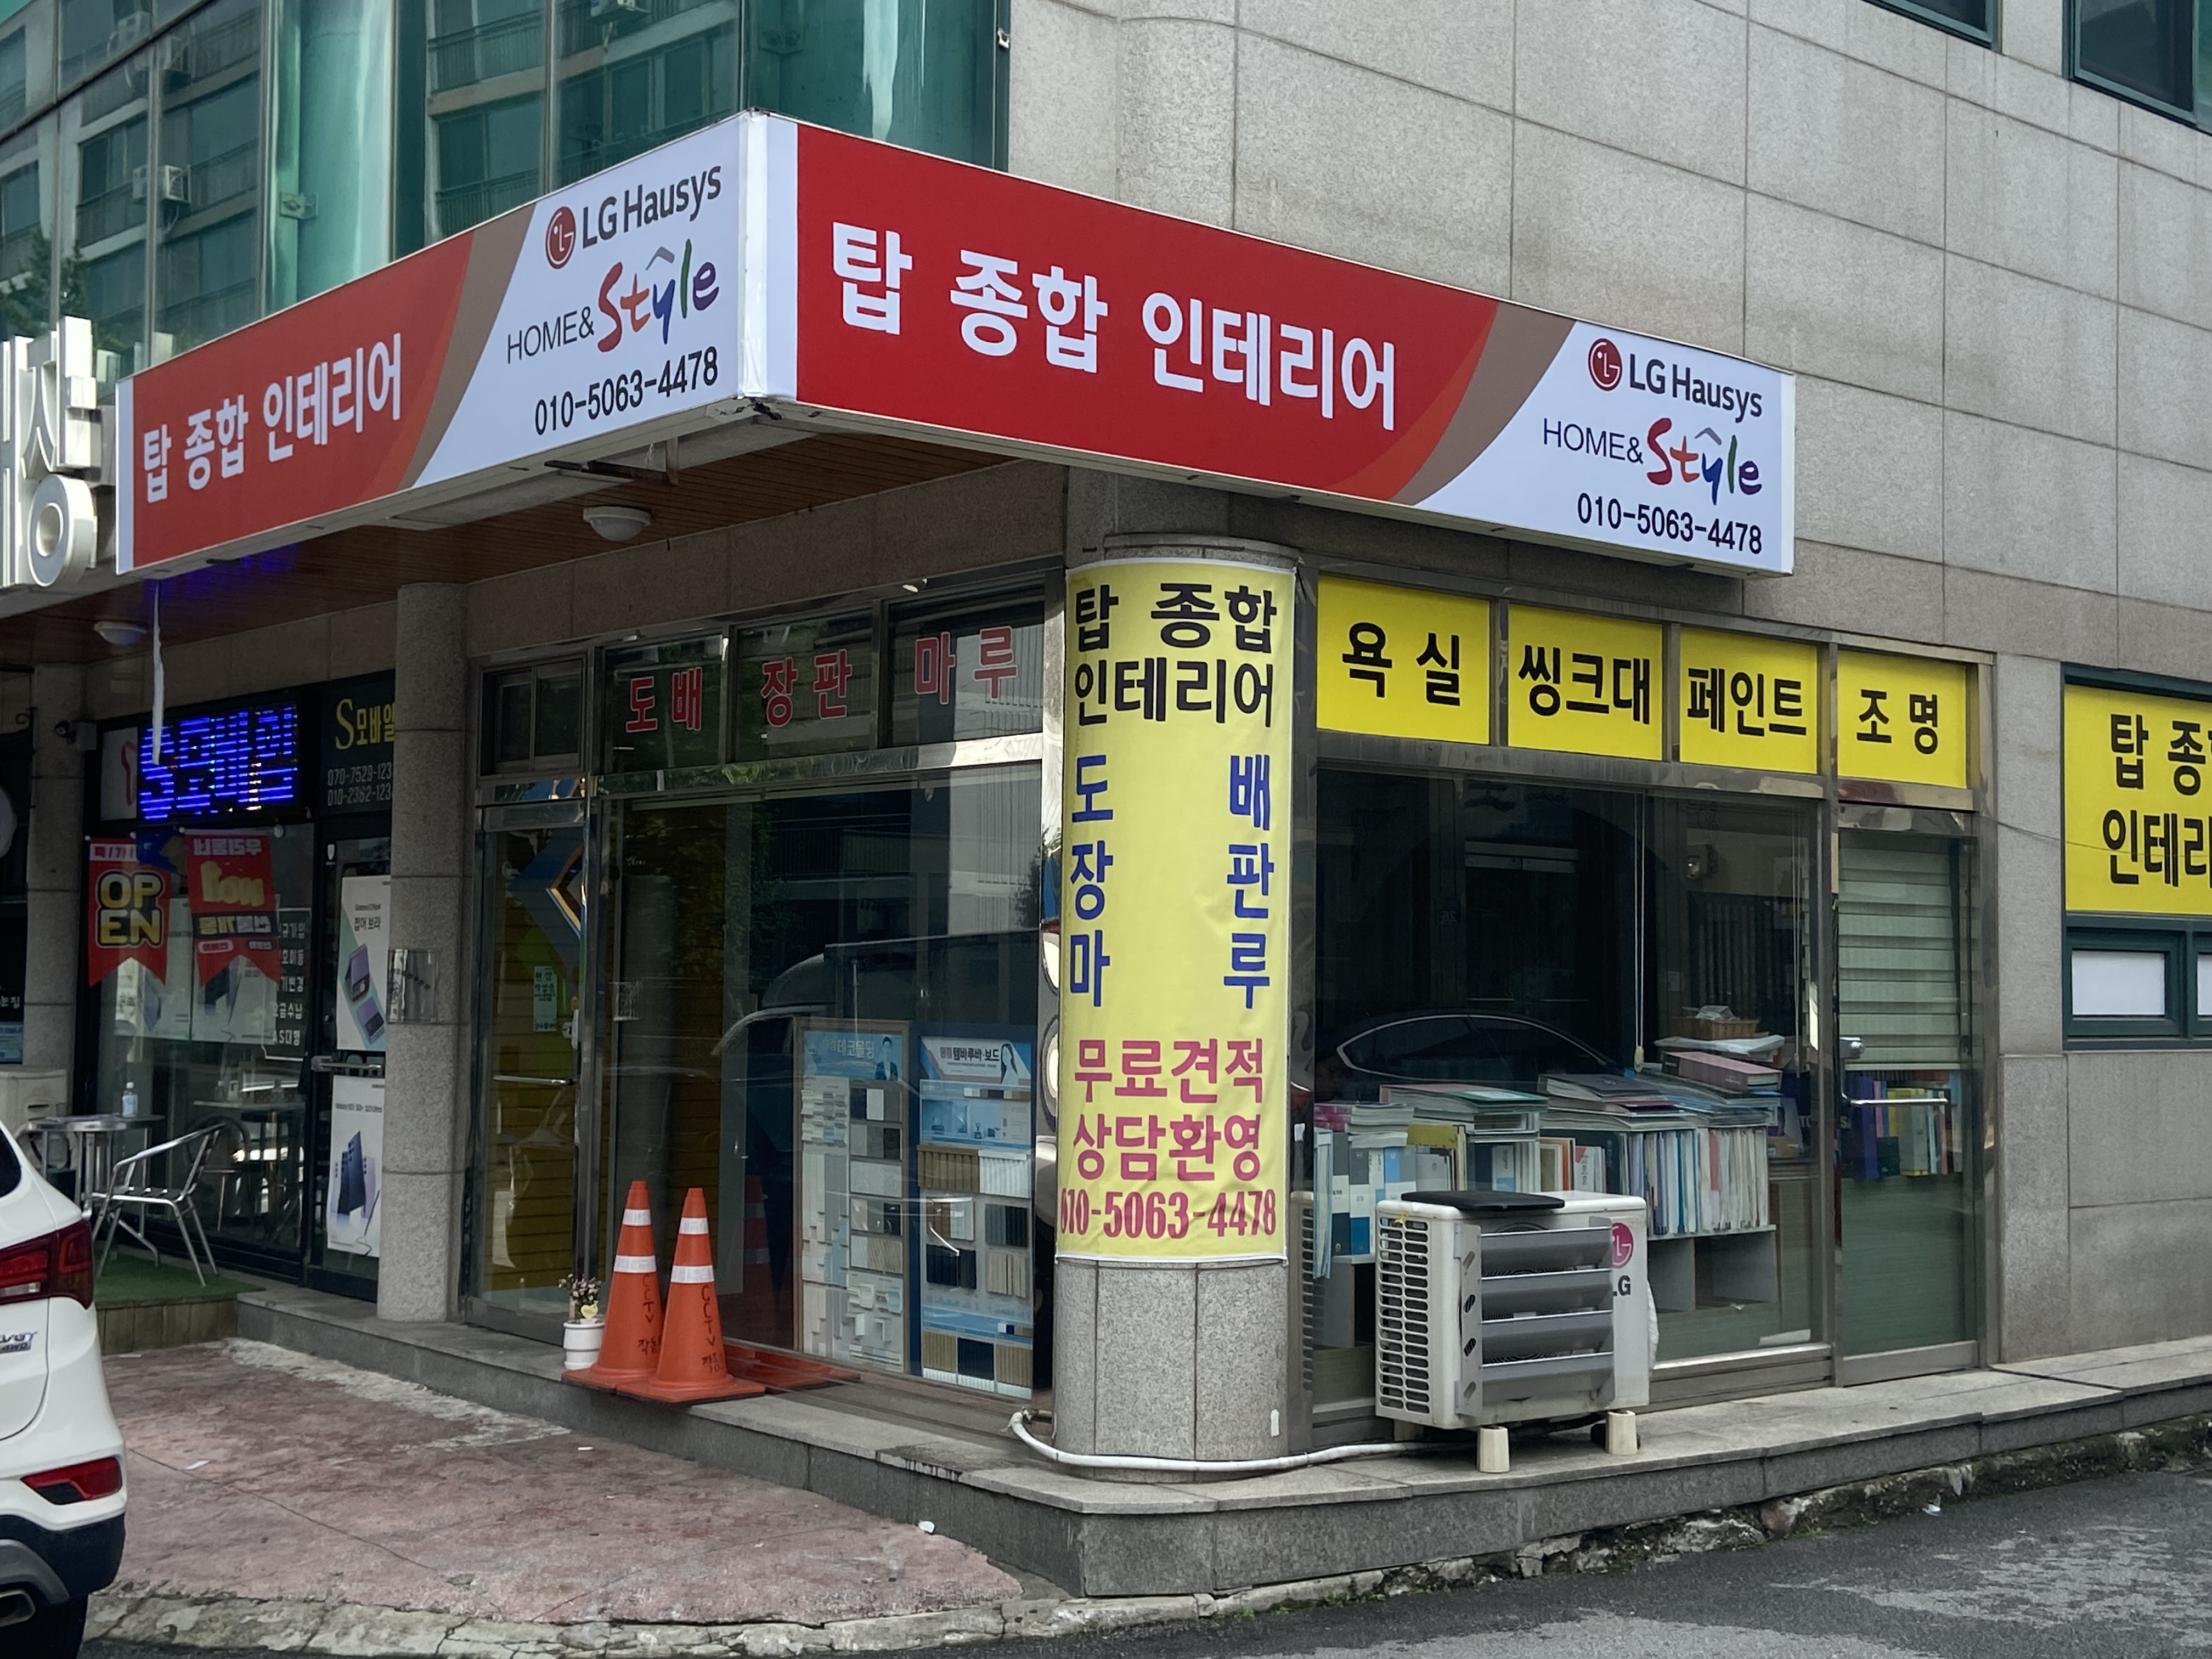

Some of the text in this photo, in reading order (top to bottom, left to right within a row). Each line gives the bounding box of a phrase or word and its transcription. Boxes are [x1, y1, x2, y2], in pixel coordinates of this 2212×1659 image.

[583, 196, 617, 249] LG
[624, 166, 721, 233] Hausys
[833, 222, 1394, 431] 탑 종합 인테리어
[144, 332, 400, 503] 탑 종합 인테리어
[535, 346, 718, 435] 010-5063-4478
[1630, 354, 1666, 394] LG
[1673, 364, 1762, 423] Hausys
[1578, 493, 1762, 554] 010-5063-4478
[1076, 583, 1277, 653] 탑 종합
[625, 666, 702, 733] 도배
[760, 649, 853, 728] 장판
[914, 625, 1018, 705] 마루
[1075, 657, 1273, 727] 인테리어
[1342, 622, 1461, 707] 욕실
[1519, 645, 1650, 725] 씽크대
[1687, 667, 1807, 737] 페인트
[1857, 689, 1938, 754] 조명
[2110, 713, 2212, 796] 탑 종
[1074, 1039, 1262, 1103] 무료견적
[1073, 1113, 1261, 1181] 상담환영
[1061, 1188, 1276, 1239] 010-5063-4478
[642, 1274, 654, 1323] CCTV
[1613, 1274, 1630, 1296] G
